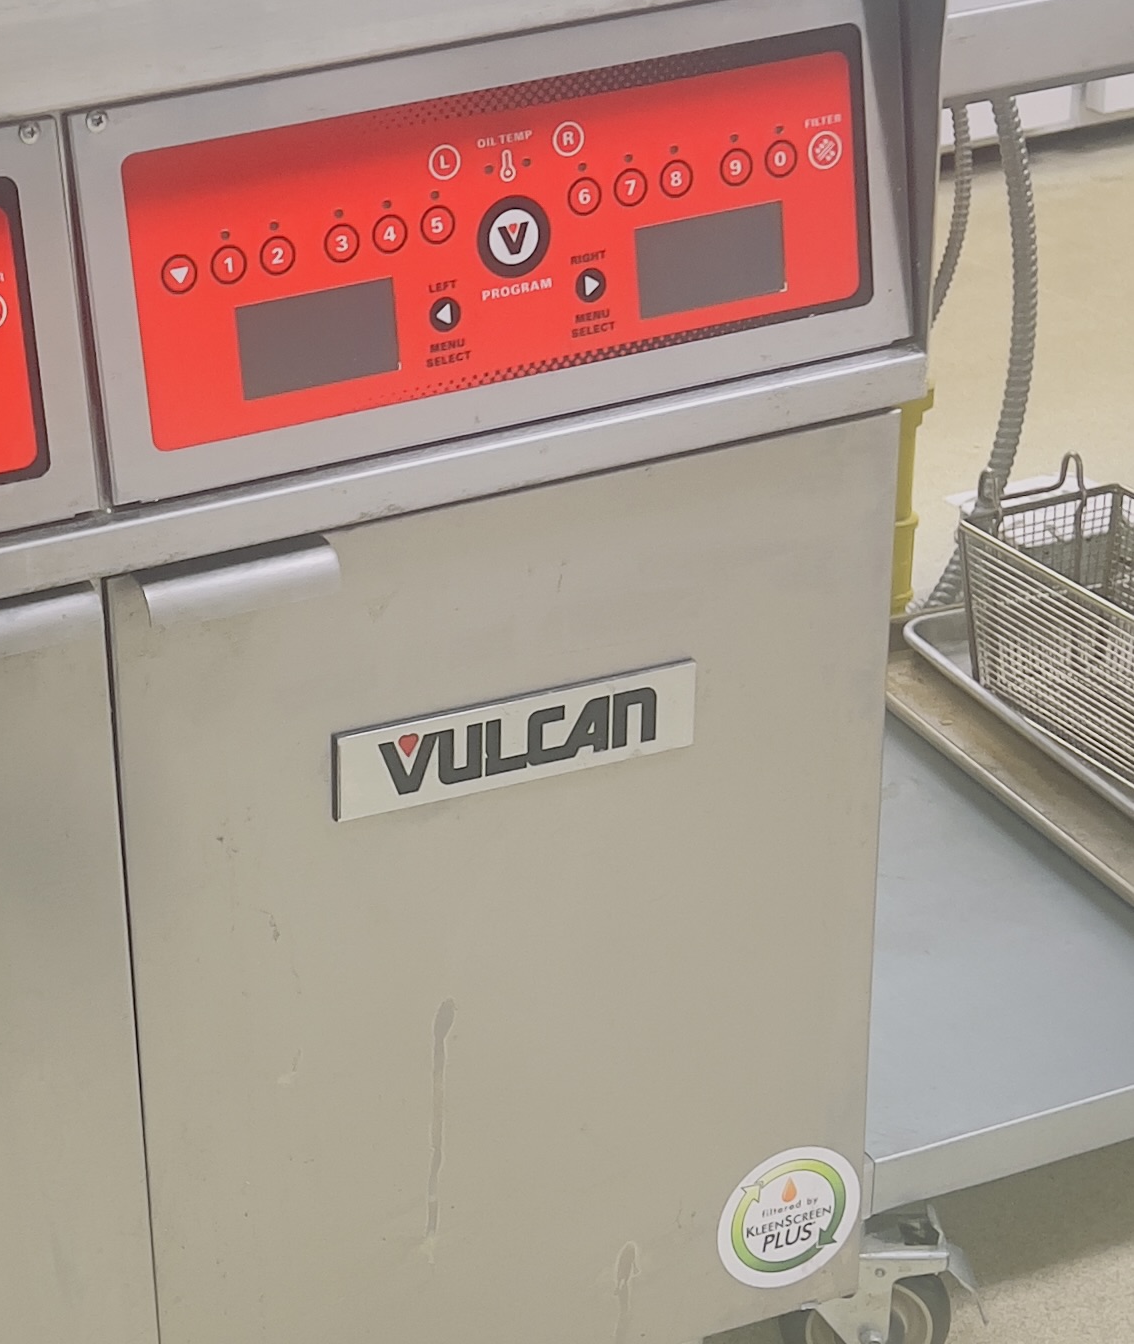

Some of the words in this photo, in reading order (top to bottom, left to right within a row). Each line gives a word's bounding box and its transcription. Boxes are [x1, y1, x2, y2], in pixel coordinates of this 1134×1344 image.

[804, 113, 842, 129] FILTER
[477, 135, 496, 149] OIL
[498, 129, 533, 145] TEMP
[562, 131, 575, 146] R
[439, 155, 450, 169] L
[729, 159, 742, 176] 9
[774, 151, 786, 167] 0
[578, 188, 591, 204] 6
[625, 180, 637, 196] 7
[670, 170, 682, 187] 8
[336, 235, 349, 251] 3
[383, 226, 397, 242] 4
[431, 217, 444, 233] 5
[498, 221, 530, 256] V
[224, 257, 234, 273] 1
[271, 248, 284, 264] 2
[570, 250, 606, 265] RIGHT
[428, 279, 458, 294] LEFT
[481, 277, 553, 301] PROGRAM
[575, 308, 611, 324] MENU
[571, 321, 616, 338] SELECT
[429, 338, 466, 354] MENU
[426, 350, 472, 368] SELECT
[378, 686, 657, 796] VULCAN
[761, 1199, 802, 1218] filtered
[806, 1197, 819, 1206] by
